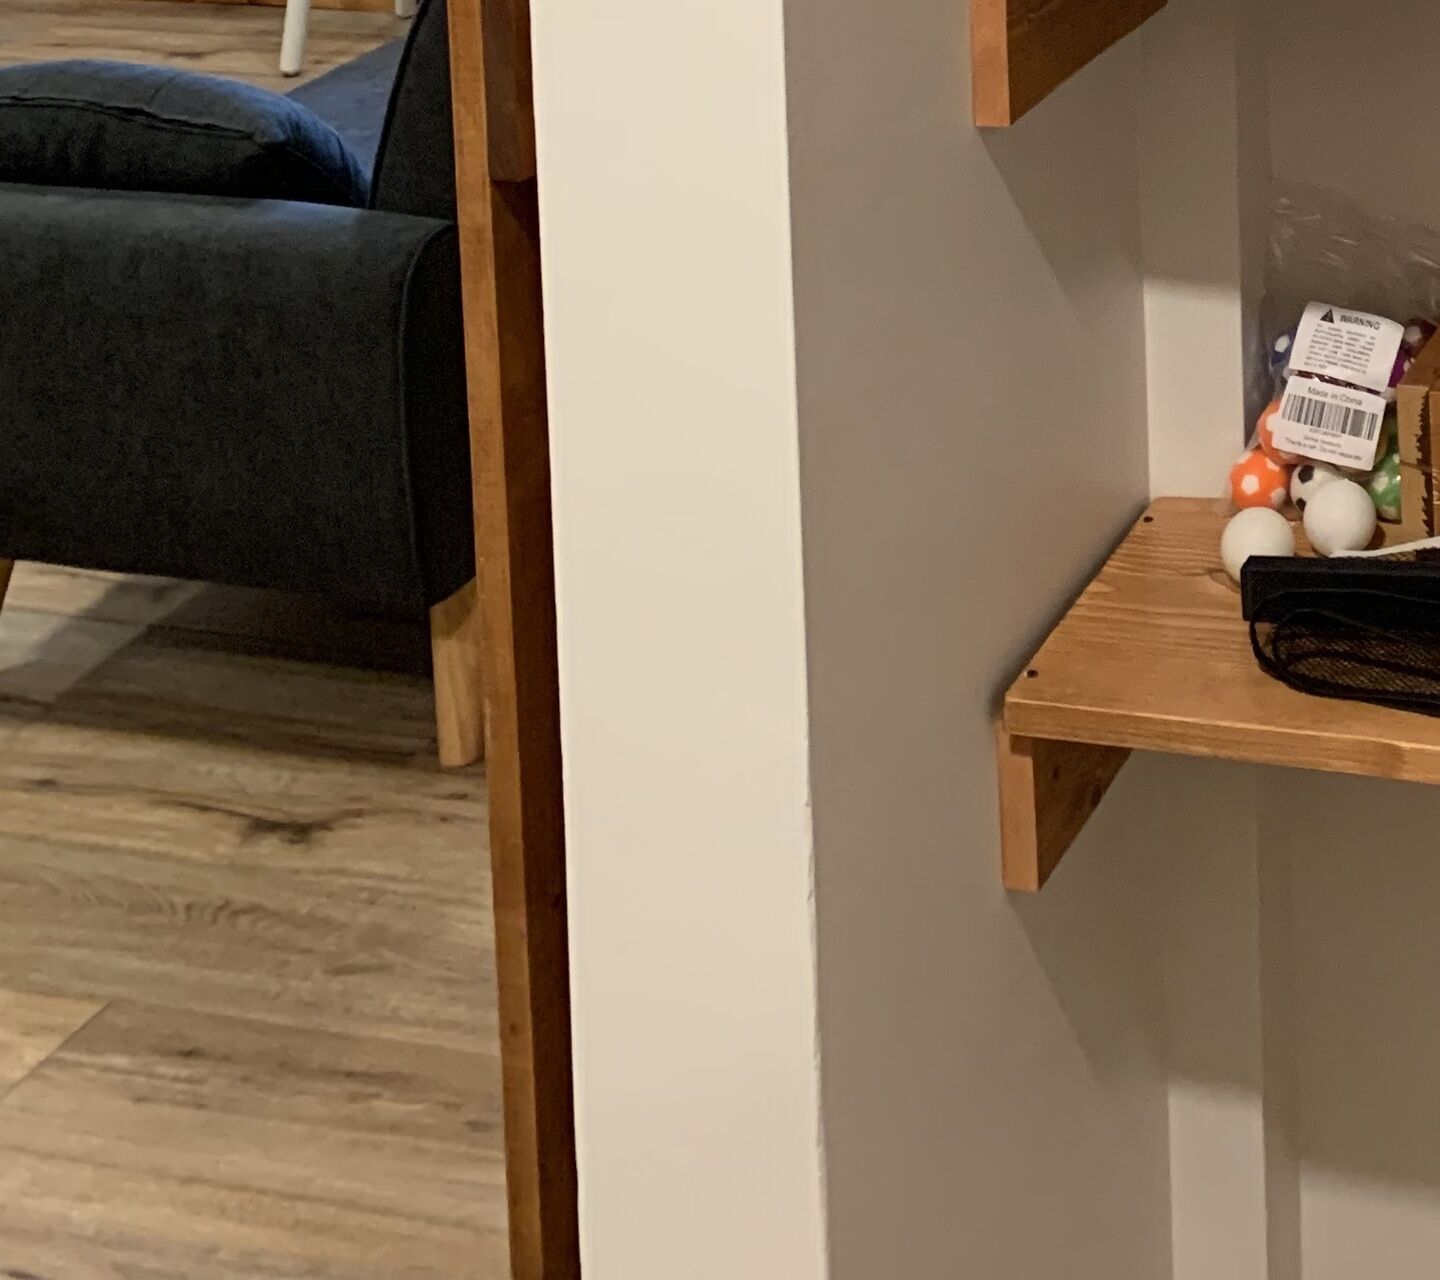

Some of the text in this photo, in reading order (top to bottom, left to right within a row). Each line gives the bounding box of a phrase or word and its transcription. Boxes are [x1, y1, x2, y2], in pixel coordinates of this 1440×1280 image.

[1340, 314, 1381, 331] WARNING
[1308, 387, 1329, 398] Made
[1339, 394, 1363, 406] China
